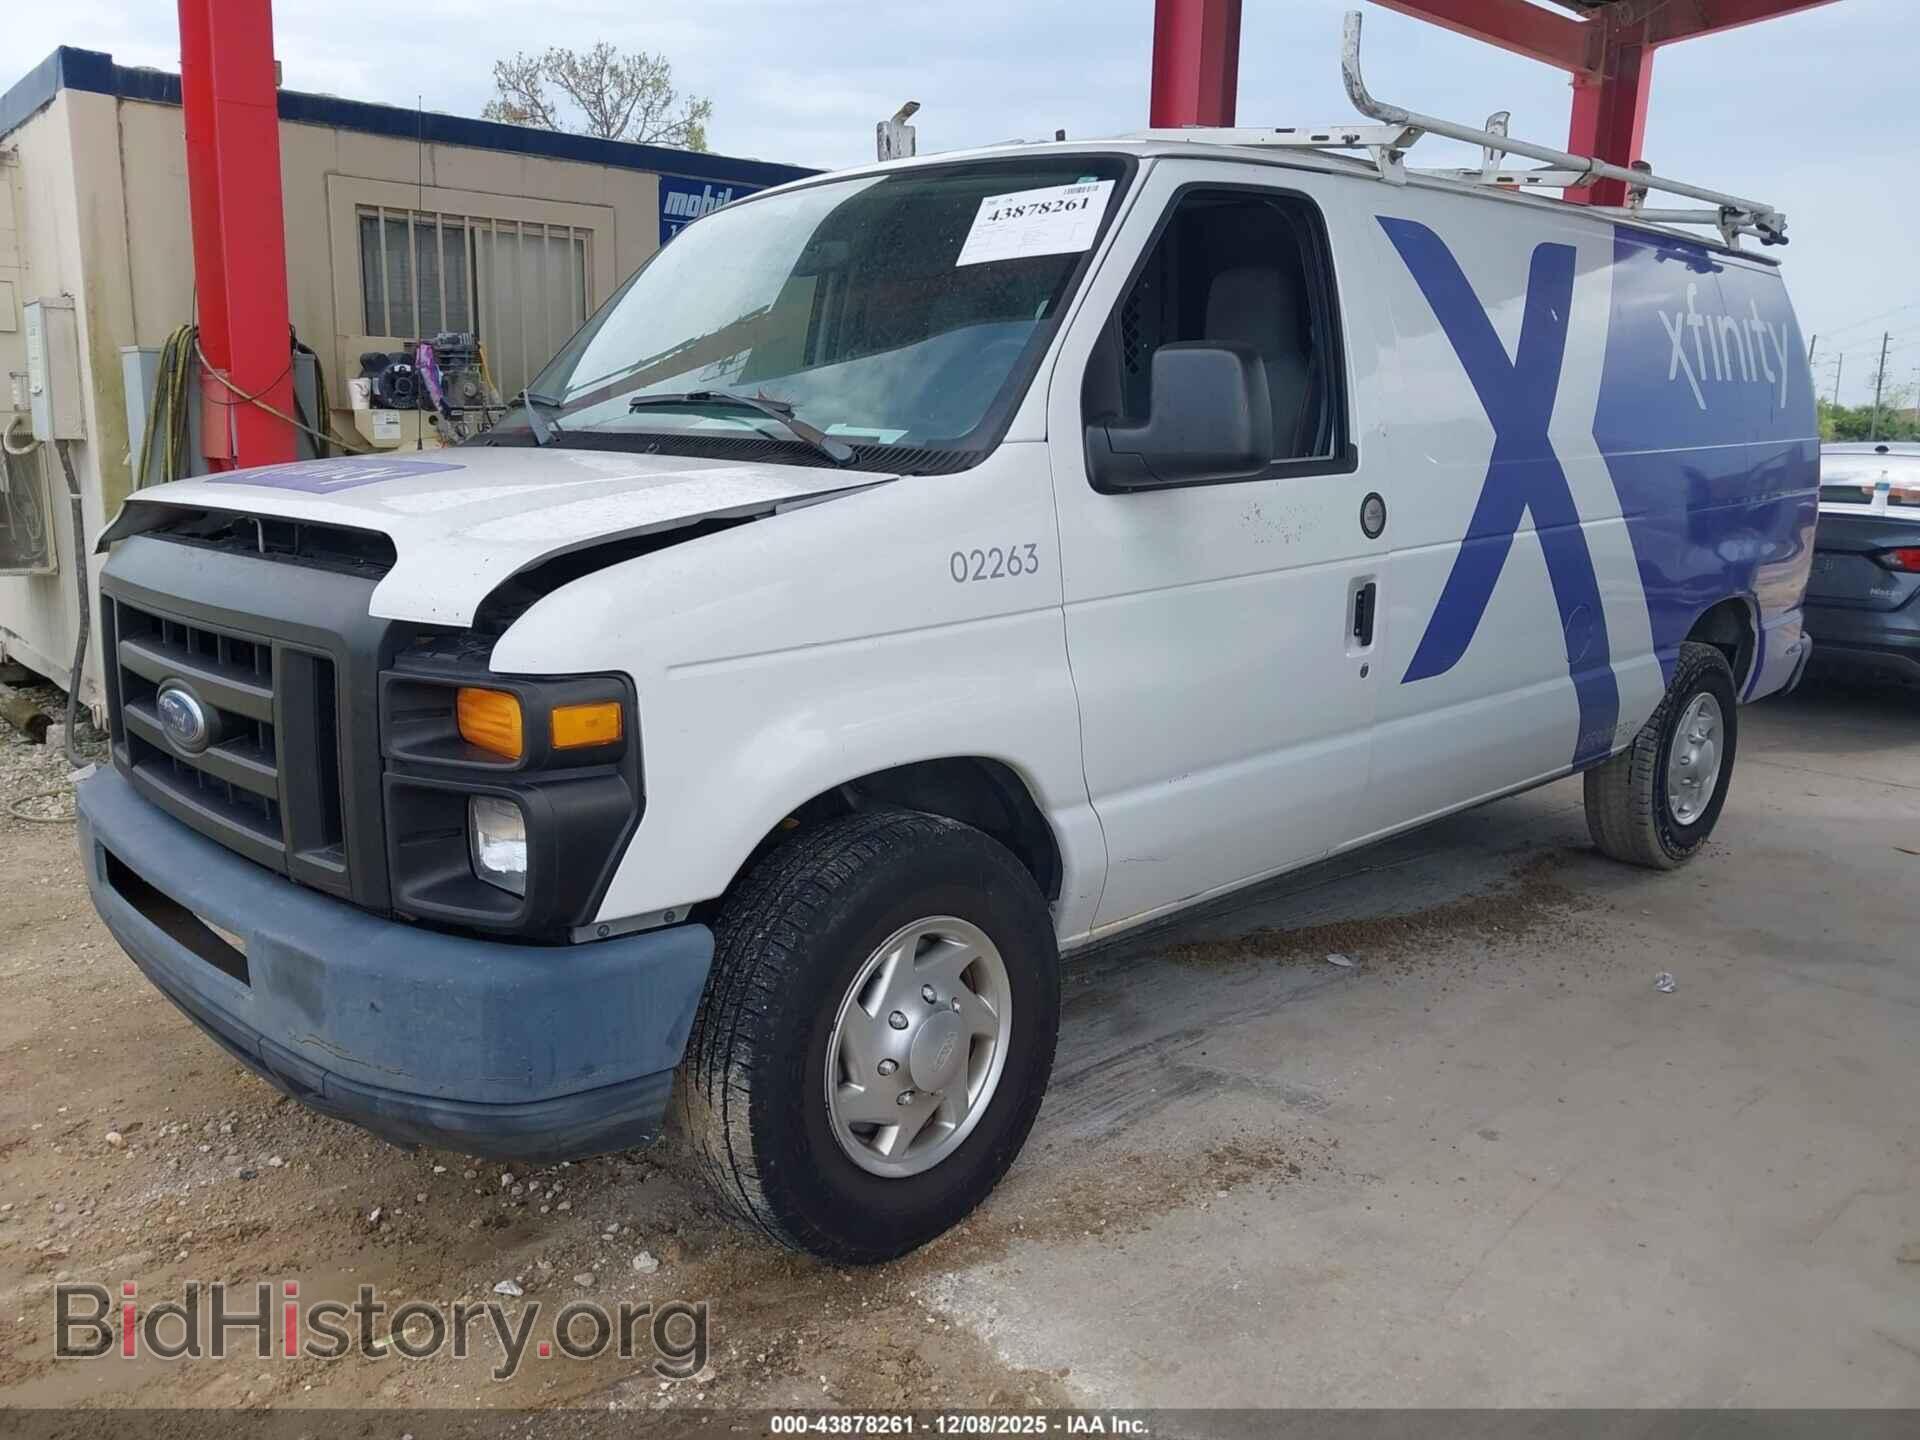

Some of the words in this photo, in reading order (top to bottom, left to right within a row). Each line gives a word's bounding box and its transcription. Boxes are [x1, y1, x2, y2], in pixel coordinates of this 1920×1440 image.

[986, 197, 1090, 222] 43878261
[1656, 282, 1789, 411] xfinity
[950, 543, 1039, 583] 02263
